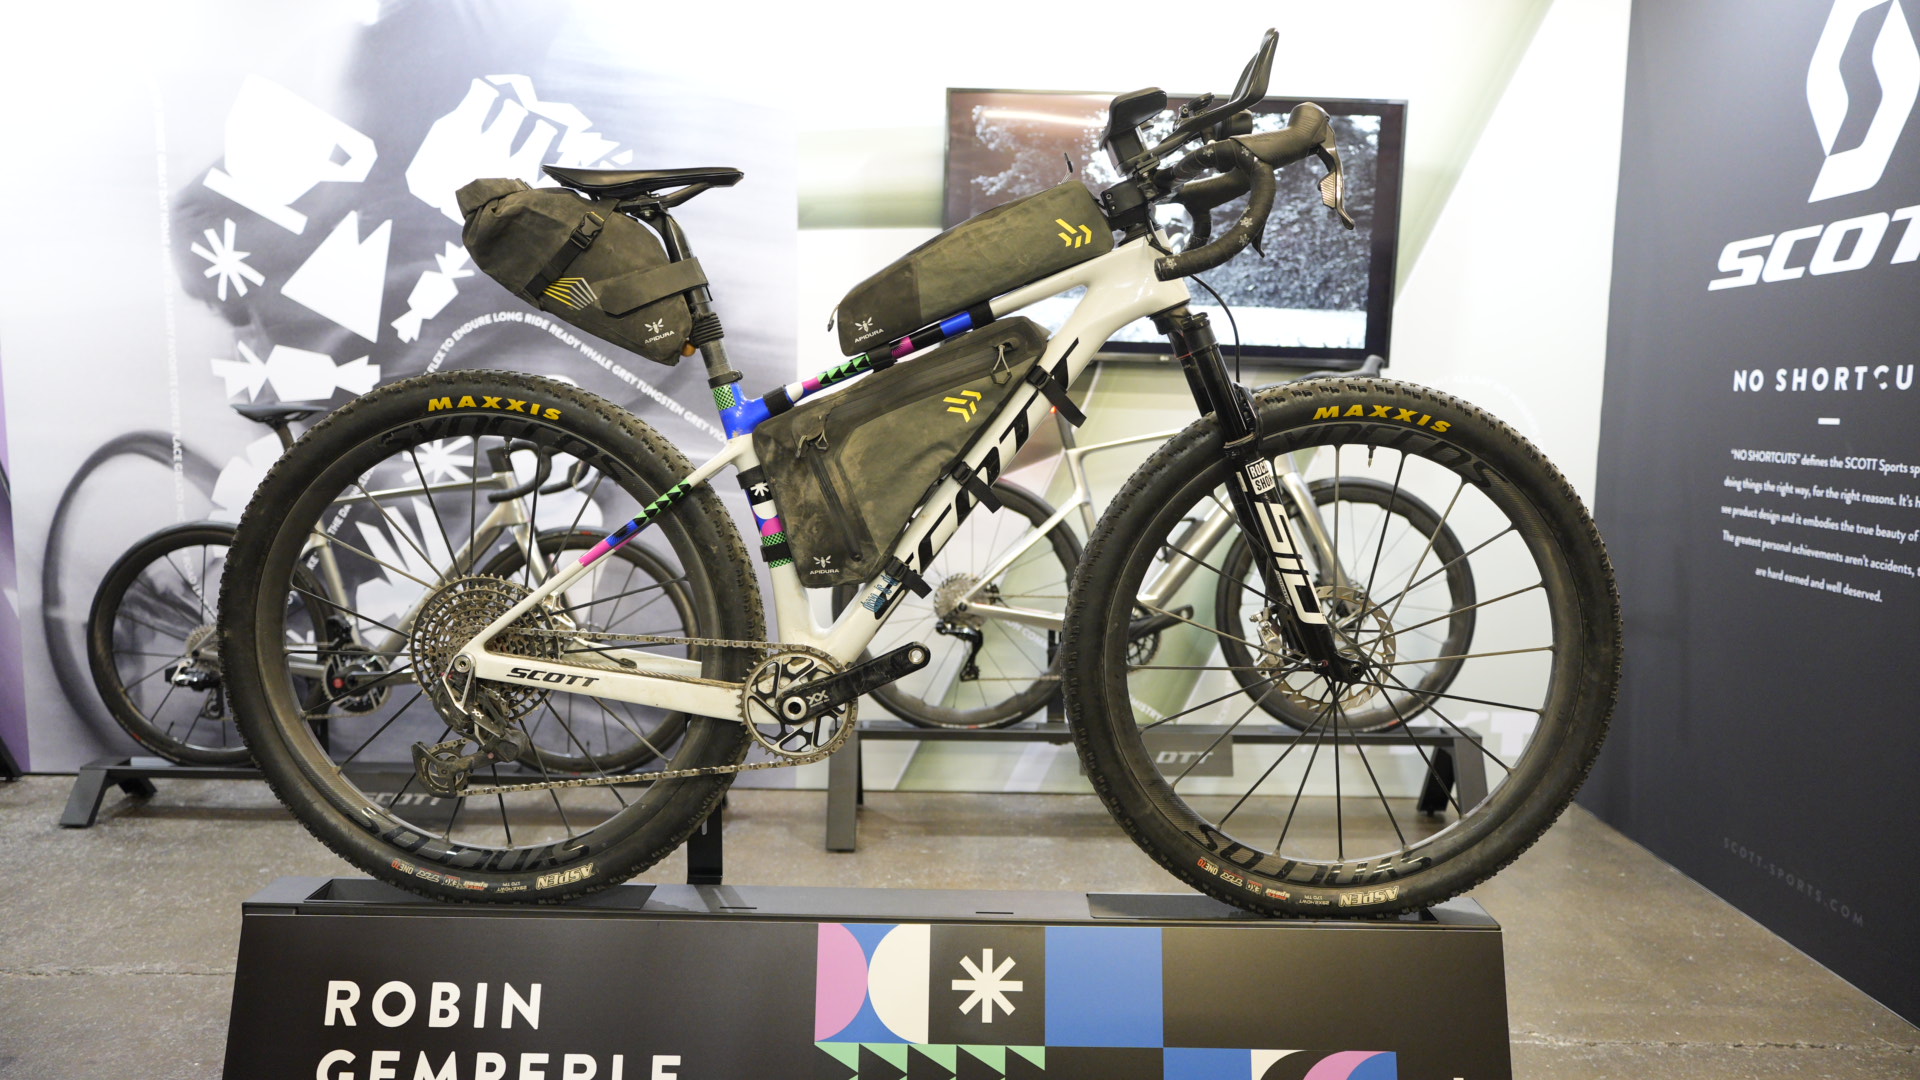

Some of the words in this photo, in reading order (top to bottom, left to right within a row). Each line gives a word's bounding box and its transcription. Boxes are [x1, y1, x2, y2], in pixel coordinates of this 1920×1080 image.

[645, 330, 675, 344] APIDURA
[854, 328, 884, 344] APIDURA
[427, 350, 446, 374] FLEX
[440, 336, 455, 354] TO
[452, 313, 492, 342] ENDURE
[493, 311, 523, 324] LONG
[524, 312, 549, 331] RIDE
[548, 323, 582, 348] READY
[579, 342, 613, 371] WHALE
[611, 363, 639, 389] GREY
[636, 377, 685, 416] TUNGSTEN
[683, 409, 709, 433] GREY
[1733, 368, 1764, 392] NO
[428, 395, 562, 421] MAXXIS
[1312, 404, 1452, 433] MAXXIS
[1829, 456, 1844, 468] the
[1844, 456, 1878, 471] SCOTT
[1879, 459, 1908, 476] Sports
[1742, 478, 1763, 494] things
[1763, 480, 1776, 492] the
[1776, 481, 1794, 497] right
[1812, 484, 1825, 497] for
[1825, 486, 1839, 499] the
[1840, 488, 1860, 505] right
[1862, 494, 1897, 506] reasons.
[1899, 493, 1913, 507] It's
[327, 515, 344, 535] THE
[1732, 505, 1757, 519] product
[1758, 507, 1781, 525] design
[1781, 512, 1795, 524] and
[1795, 513, 1802, 525] it
[1803, 515, 1839, 530] embodies
[1840, 520, 1855, 533] the
[1856, 524, 1875, 535] true
[1875, 524, 1906, 544] beauty
[1908, 529, 1920, 542] of
[1722, 529, 1735, 543] The
[1734, 535, 1761, 547] greatest
[1761, 541, 1791, 552] personal
[1791, 543, 1843, 562] achievements
[1844, 554, 1869, 568] aren't
[1869, 558, 1915, 578] accidents,
[1755, 567, 1767, 578] are
[1767, 566, 1784, 581] hard
[1784, 574, 1809, 587] earned
[1810, 577, 1825, 590] and
[1826, 581, 1843, 594] well
[1843, 583, 1883, 603] deserved.
[506, 667, 600, 688] SCOTT
[806, 689, 830, 706] XX
[471, 708, 485, 720] XX
[391, 859, 414, 875] ONE70
[536, 862, 594, 891] ASPEN
[1197, 858, 1219, 876] ONE70
[1723, 837, 1864, 928] SCOTT-SPORTS.COM
[1338, 886, 1400, 907] ASPEN
[323, 980, 543, 1030] ROBIN
